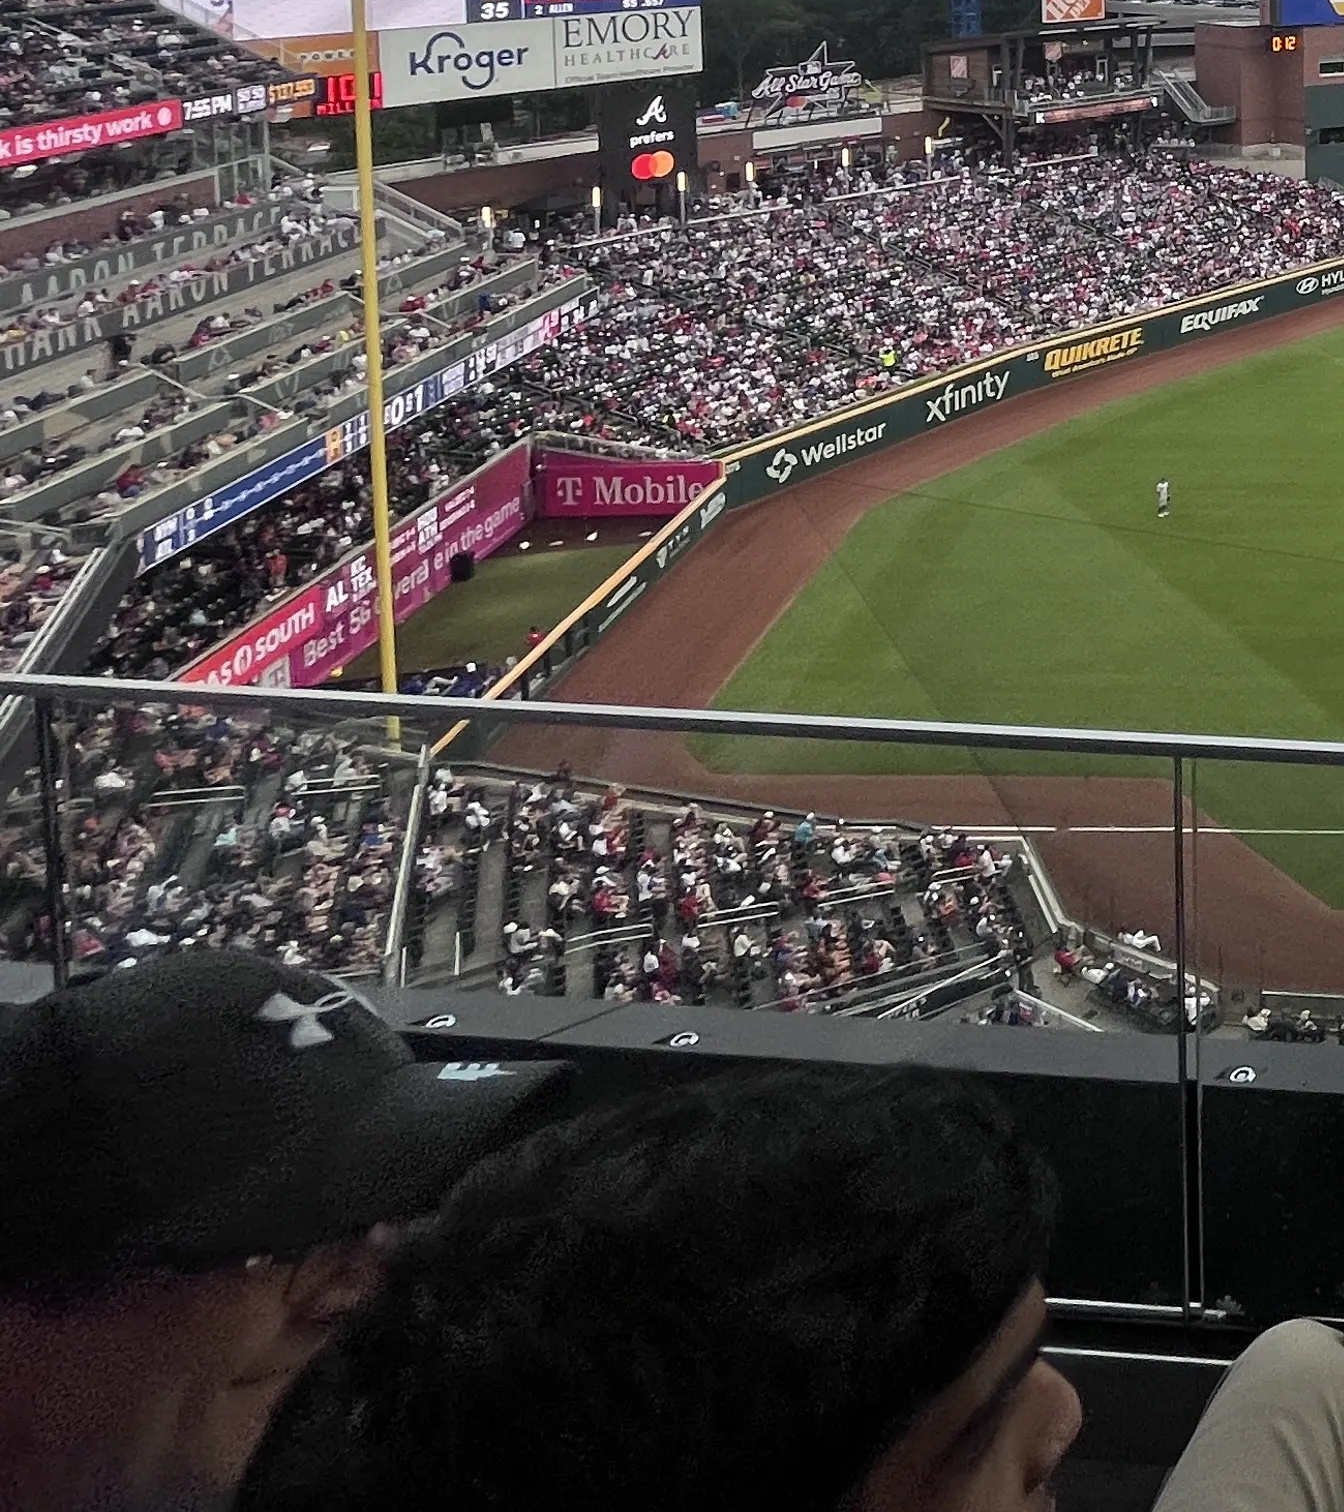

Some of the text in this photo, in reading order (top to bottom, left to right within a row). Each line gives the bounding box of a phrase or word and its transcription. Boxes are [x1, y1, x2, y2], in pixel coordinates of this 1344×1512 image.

[480, 2, 509, 18] 35
[561, 9, 695, 49] EMORY
[409, 32, 528, 90] Kroger
[1272, 37, 1296, 52] 0:12
[212, 94, 233, 115] PM
[15, 136, 34, 155] is
[37, 123, 101, 152] thirsty
[107, 112, 153, 137] work
[630, 131, 674, 149] prefers
[1180, 296, 1260, 334] EQUIFAX
[1044, 328, 1143, 373] QUIKRETE
[926, 370, 1011, 424] xfinity
[800, 421, 887, 467] Wellstar
[594, 475, 703, 506] Mobile
[304, 619, 346, 668] Best
[483, 496, 521, 542] game
[325, 584, 349, 613] AL
[255, 601, 315, 662] SOUTH
